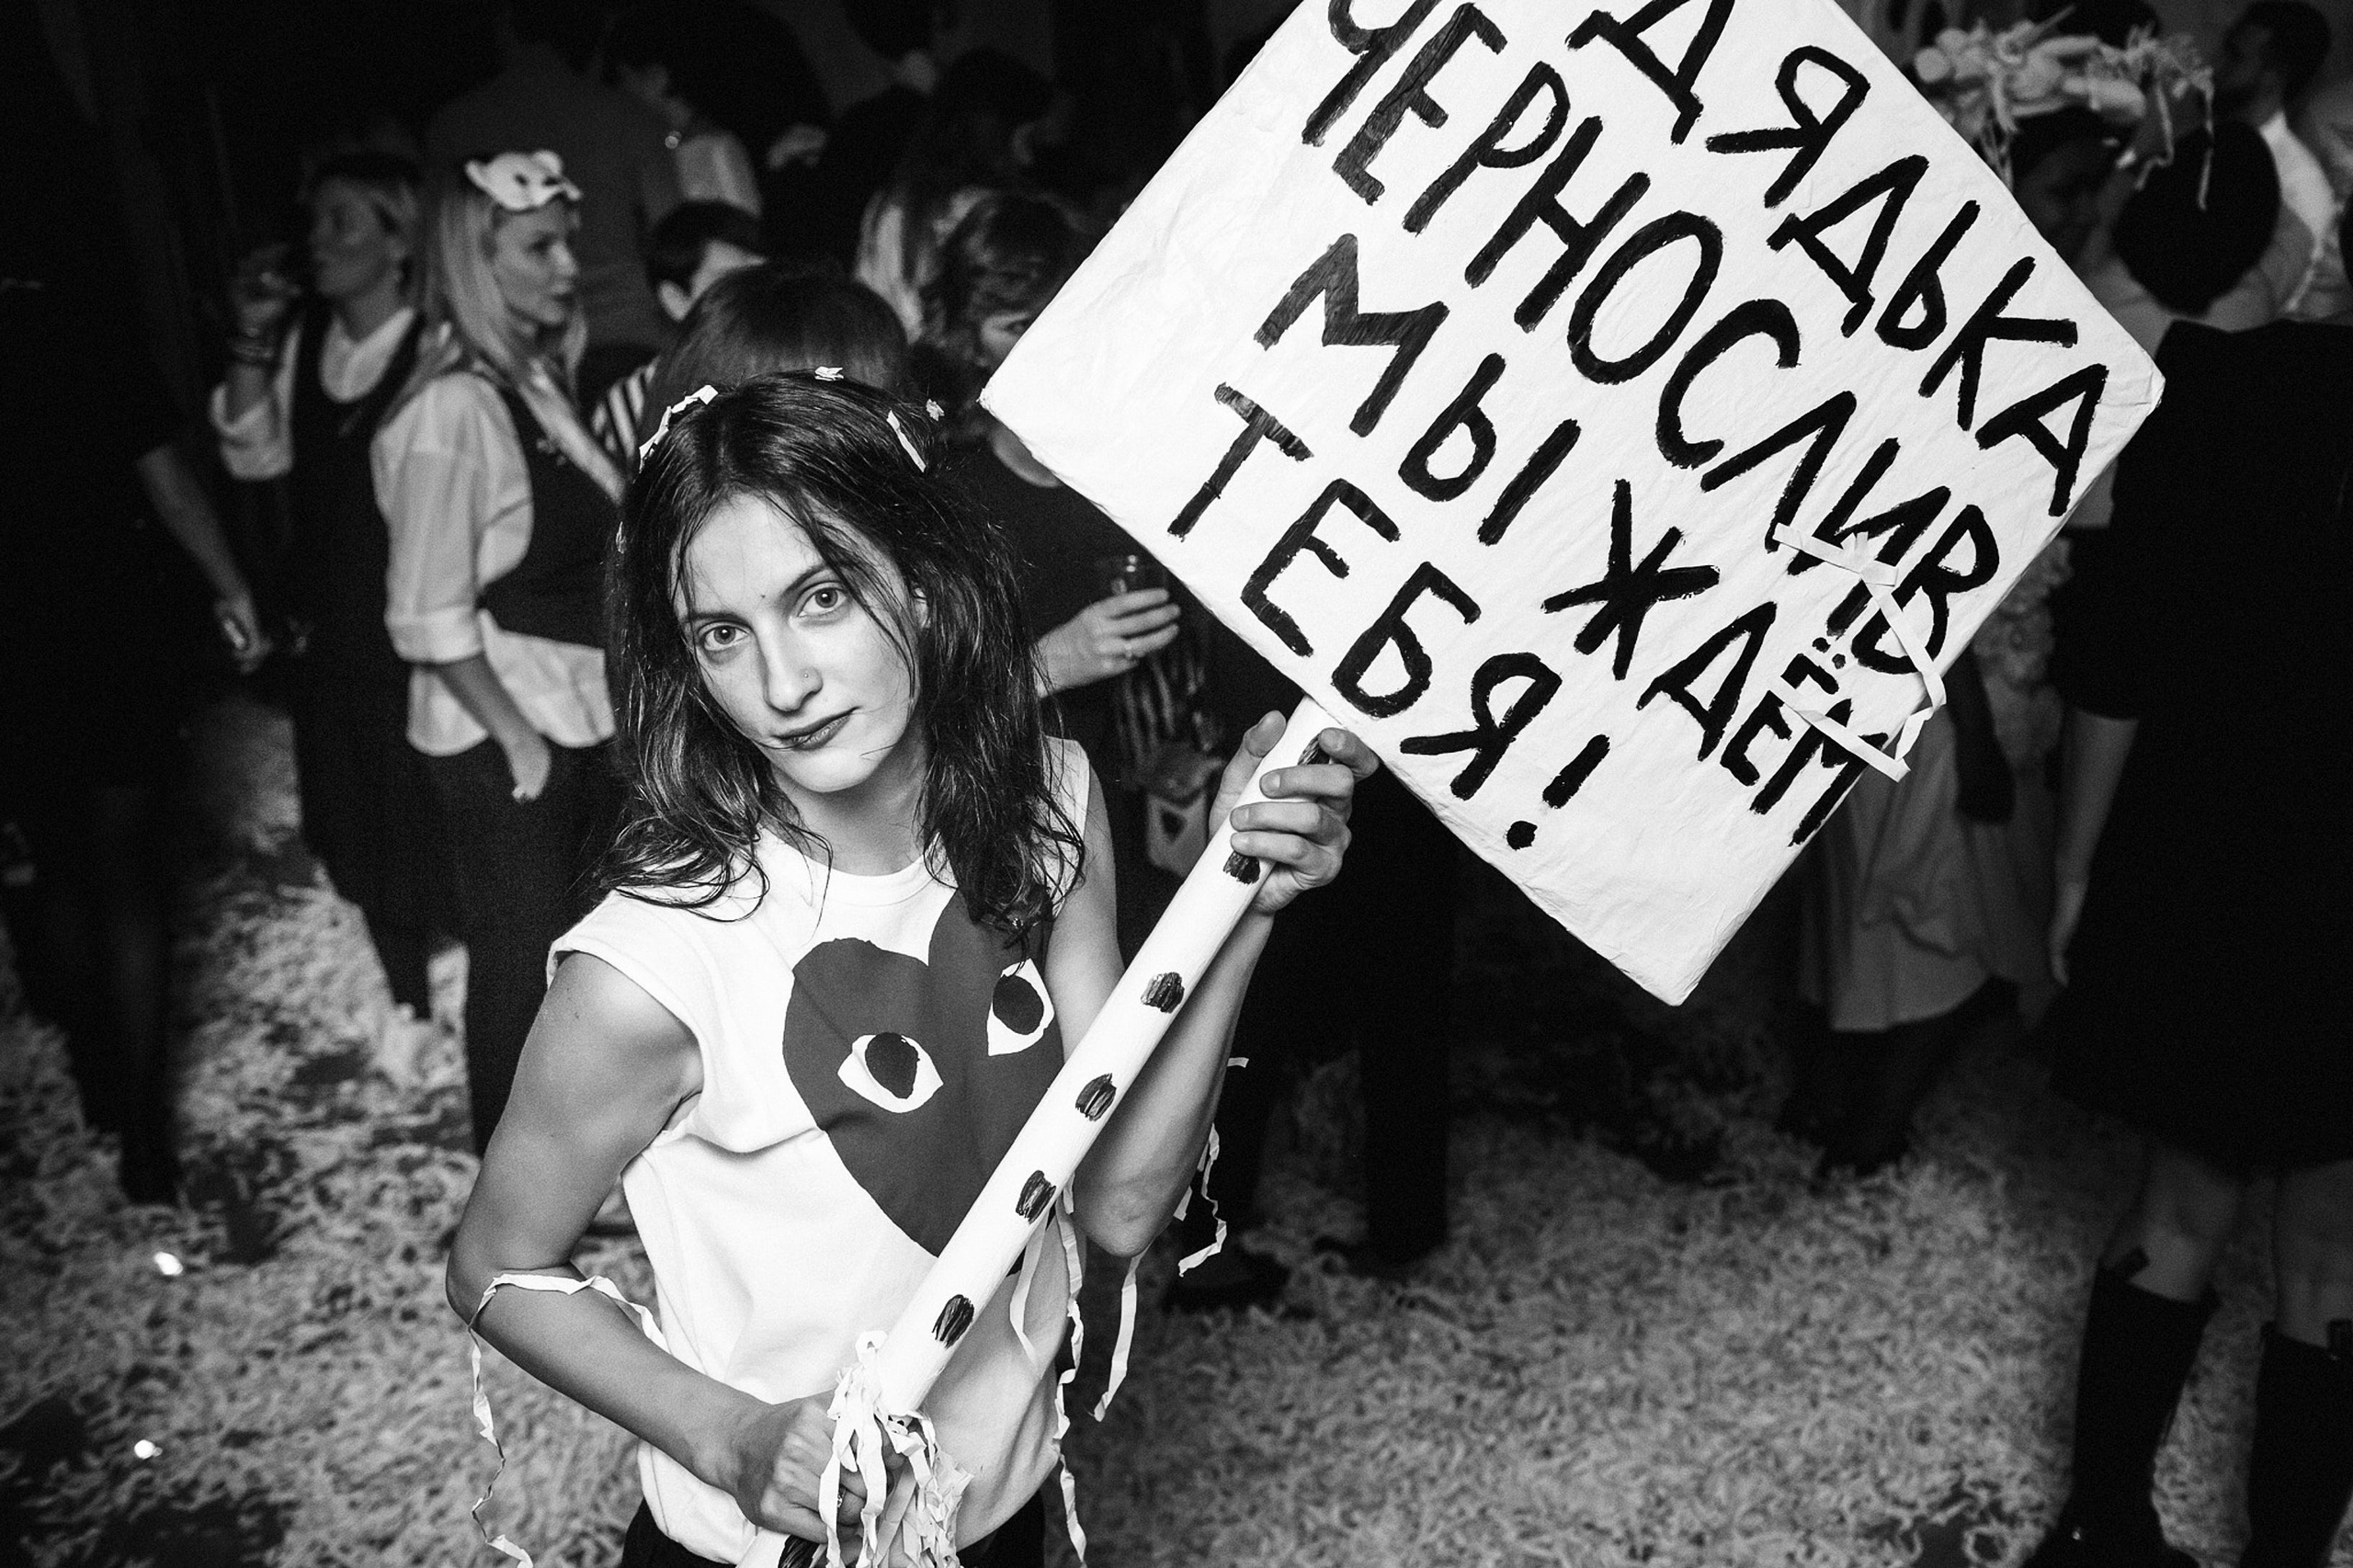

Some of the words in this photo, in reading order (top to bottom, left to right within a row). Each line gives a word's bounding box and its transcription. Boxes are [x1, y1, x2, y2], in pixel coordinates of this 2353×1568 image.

[1254, 233, 1581, 545] МЫ
[1302, 0, 2000, 674] ЧЕРНОСЛИВ
[1566, 0, 2109, 517] ДЯДЬКА
[1167, 382, 1609, 850] ТЕБЯ!
